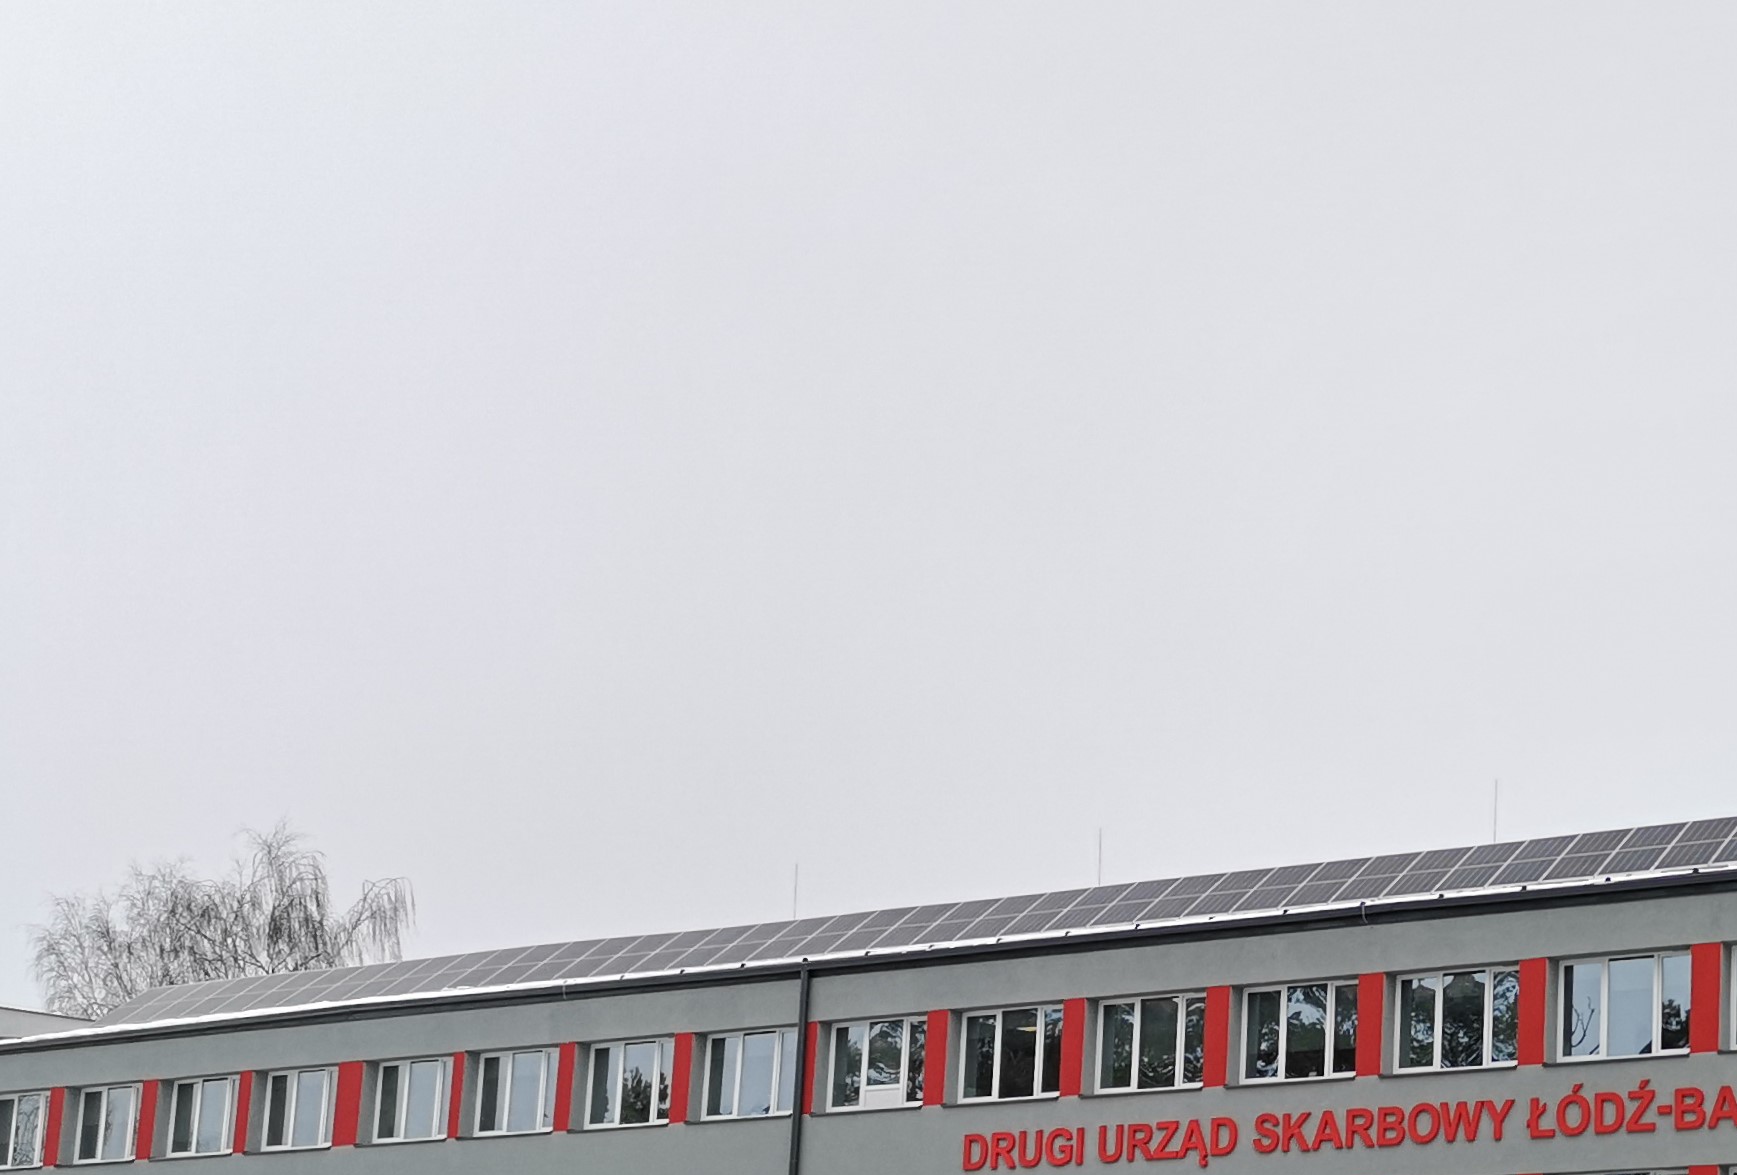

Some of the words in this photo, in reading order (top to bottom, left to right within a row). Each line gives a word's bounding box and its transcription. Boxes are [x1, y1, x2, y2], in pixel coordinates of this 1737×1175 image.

[962, 1127, 1086, 1171] DRUGI
[1098, 1116, 1240, 1168] URZĄD
[1252, 1098, 1515, 1154] SKARBOWY
